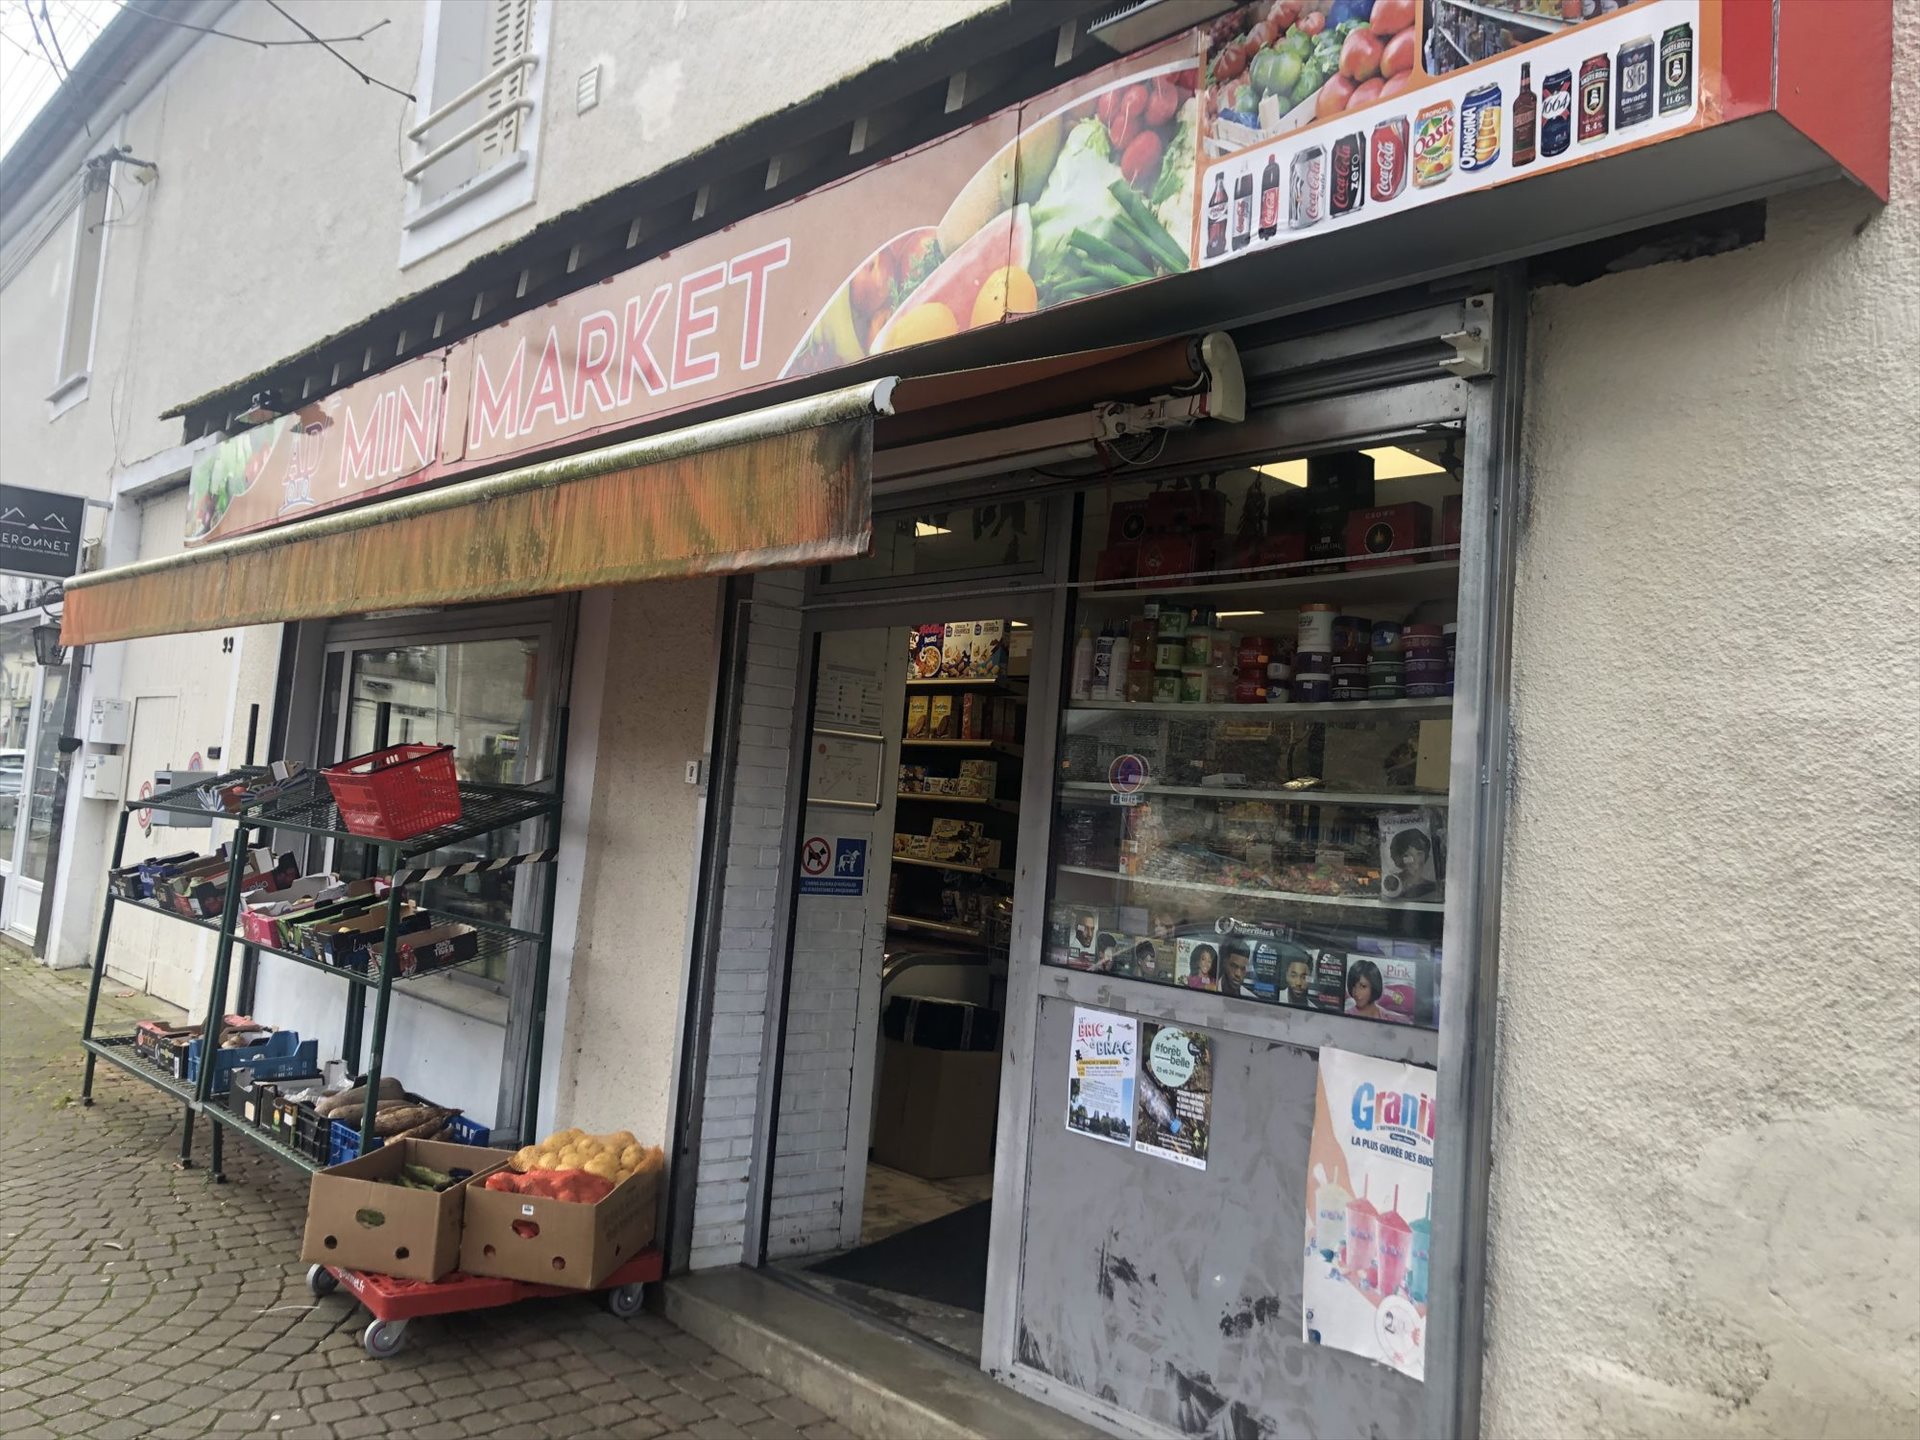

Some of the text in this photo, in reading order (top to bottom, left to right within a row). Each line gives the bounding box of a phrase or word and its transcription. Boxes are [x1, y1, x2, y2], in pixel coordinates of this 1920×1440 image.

[1543, 95, 1568, 114] 1664
[1414, 115, 1454, 159] Oasis
[1460, 106, 1476, 170] ORANGINA
[1351, 154, 1360, 191] zero
[469, 237, 792, 452] MARKET
[1234, 926, 1275, 937] SuperBlack
[1386, 966, 1411, 979] Pink
[1078, 1023, 1104, 1038] BRIC
[1096, 1040, 1134, 1056] BRAC
[1170, 1056, 1190, 1069] belle
[1351, 1136, 1362, 1146] LA
[1362, 1139, 1379, 1151] PLUS
[1379, 1143, 1404, 1158] GIVRÉE
[1404, 1150, 1416, 1163] DES
